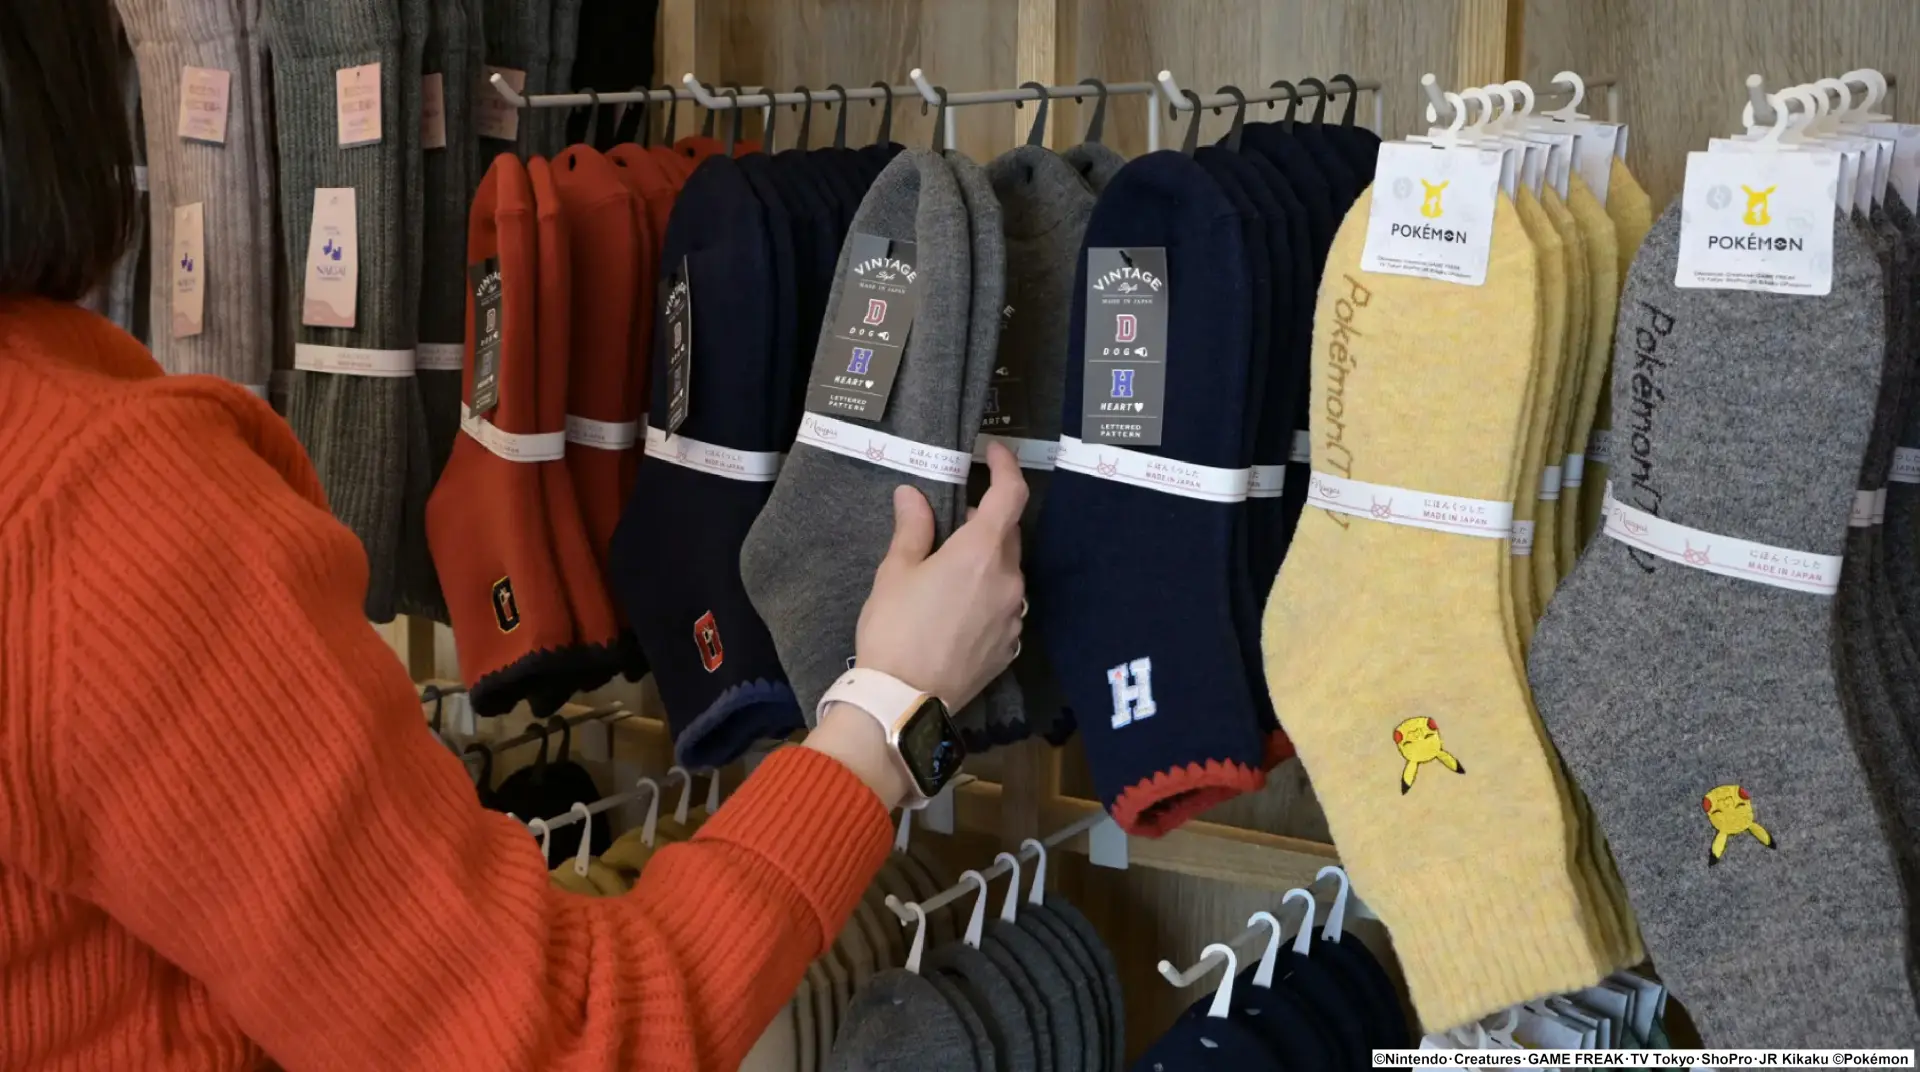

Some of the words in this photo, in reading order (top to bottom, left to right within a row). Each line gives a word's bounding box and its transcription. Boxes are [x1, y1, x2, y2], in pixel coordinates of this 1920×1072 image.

[1391, 222, 1467, 244] POKÉMON
[1708, 232, 1803, 251] POKÉMON
[854, 257, 917, 284] VINTAGE
[1092, 267, 1162, 292] VINTAGE
[863, 298, 887, 325] D
[850, 326, 875, 337] DOG
[1115, 314, 1137, 343] D
[846, 347, 874, 375] H
[1103, 347, 1130, 356] DOG
[834, 376, 863, 386] HEART
[1110, 369, 1135, 398] H
[828, 401, 865, 411] PATTERN
[830, 394, 867, 405] LETTERED
[1100, 402, 1132, 411] HEART
[1100, 430, 1141, 438] PATTERN
[1146, 472, 1165, 481] MADE
[1177, 479, 1201, 488] JAPAN
[1423, 510, 1446, 520] MADE
[1460, 516, 1487, 525] JAPAN
[1748, 561, 1775, 573] MADE
[1778, 567, 1788, 576] IN
[1791, 569, 1822, 581] JAPAN
[1107, 656, 1157, 729] H
